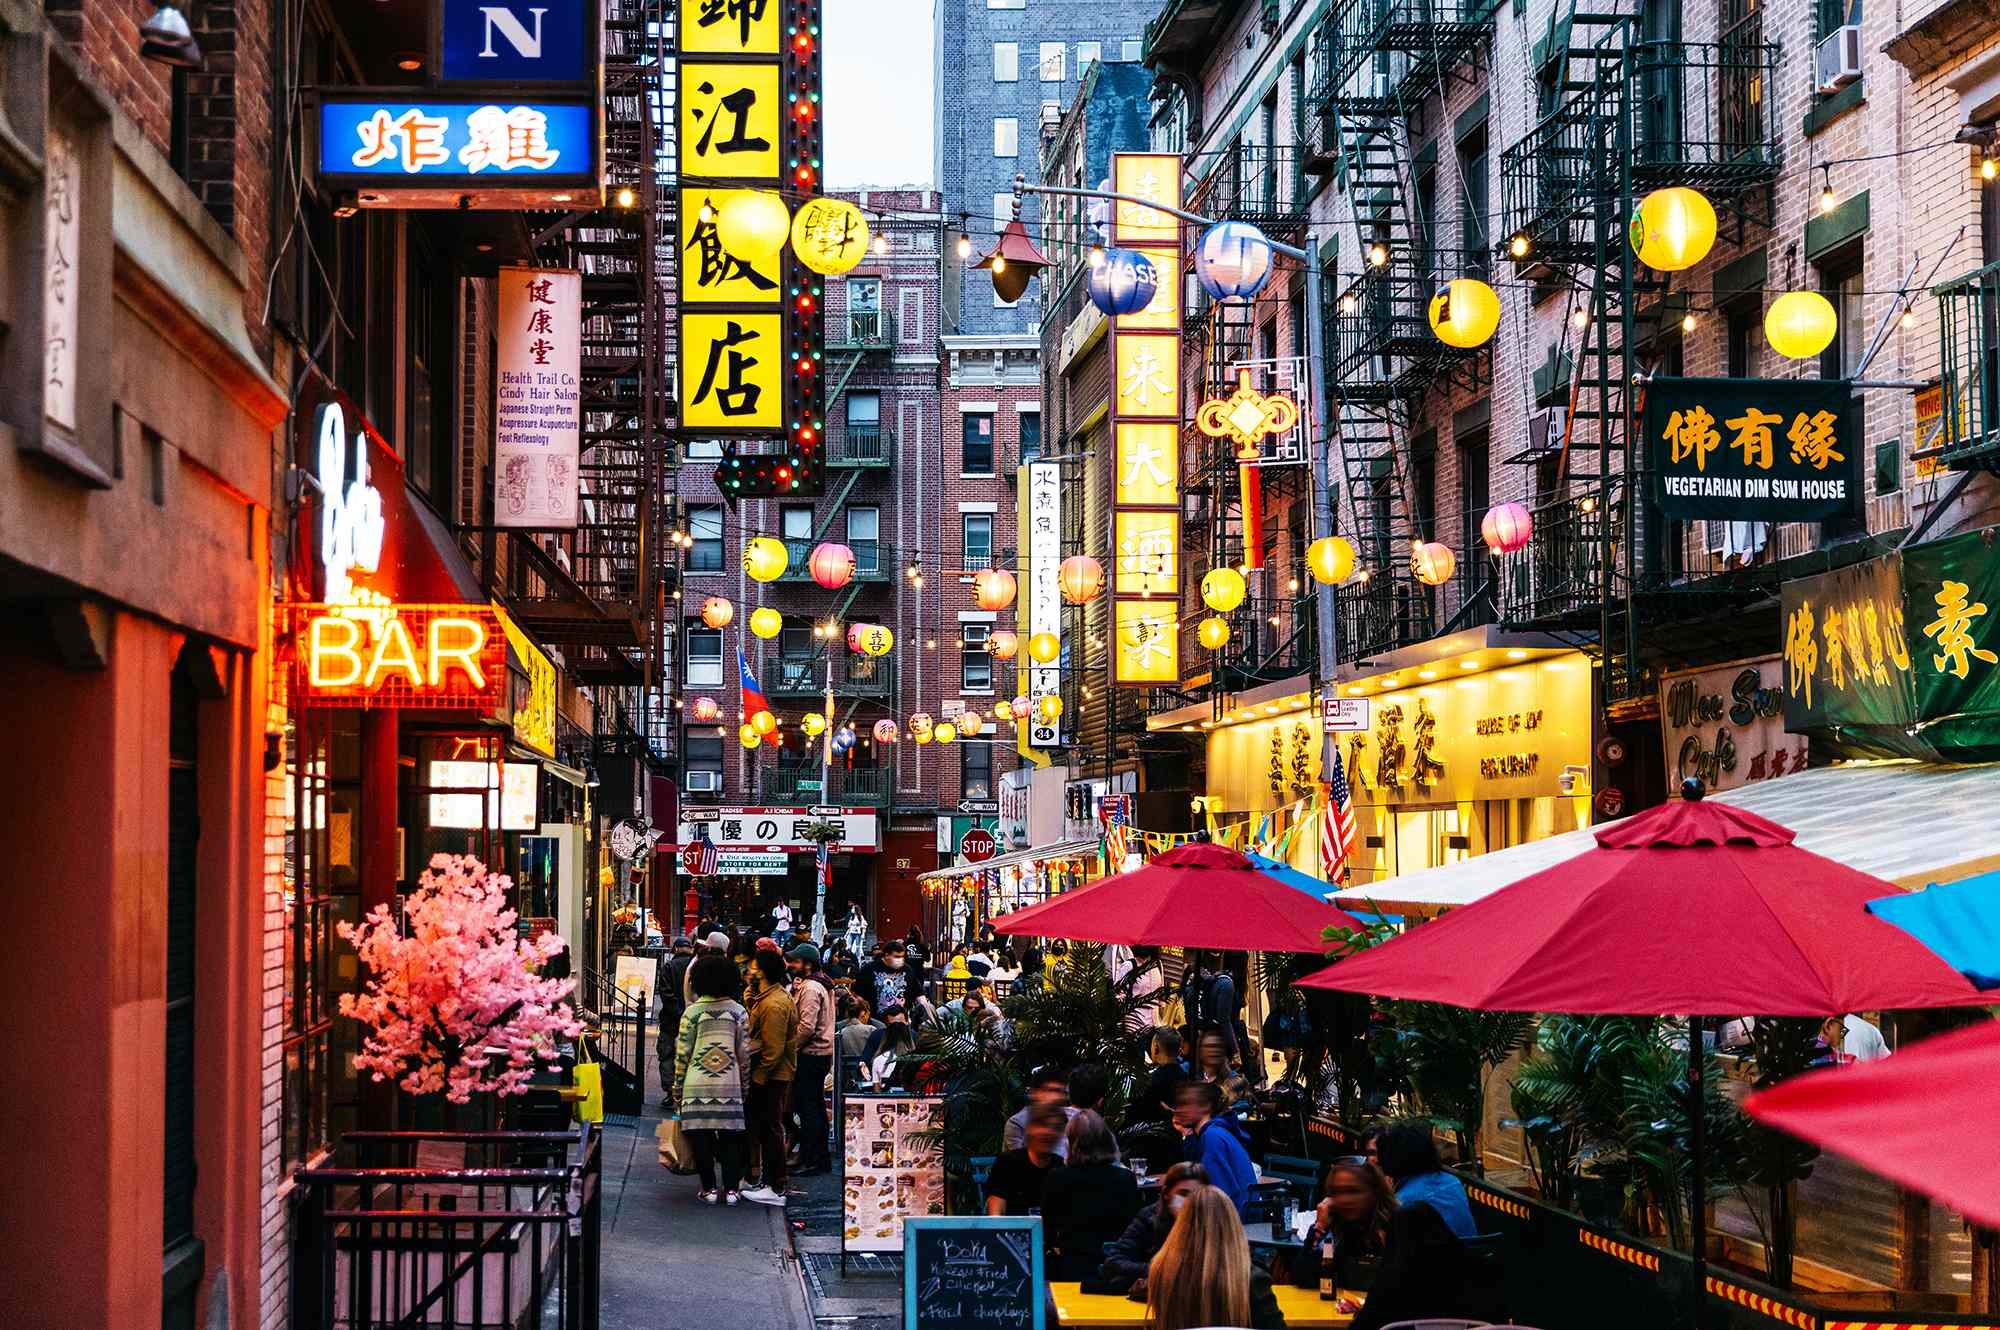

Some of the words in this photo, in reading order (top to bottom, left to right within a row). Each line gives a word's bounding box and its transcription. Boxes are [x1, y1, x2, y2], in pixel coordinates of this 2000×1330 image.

[478, 7, 549, 58] N
[351, 105, 561, 174] 炸雞
[1092, 262, 1158, 285] CHASE
[525, 279, 557, 365] 健康堂
[502, 372, 532, 385] Health
[537, 373, 558, 385] Trail
[561, 374, 576, 385] Co.
[499, 386, 526, 402] Cindy
[530, 388, 550, 400] Hair
[554, 389, 578, 401] Salon
[499, 404, 529, 416] Japanese
[530, 404, 555, 416] Straight
[556, 404, 573, 414] Perm
[499, 418, 538, 430] Acupressure
[539, 418, 578, 430] Acupuncture
[498, 432, 512, 443] Foot
[513, 432, 549, 446] Reflexology
[1662, 405, 1846, 472] 佛有緣
[1664, 476, 1742, 498] VEGETARIAN
[1744, 478, 1770, 499] DIM
[1772, 479, 1799, 499] SUM
[1801, 480, 1847, 499] HOUSE
[1923, 580, 1999, 680] 素
[309, 617, 488, 690] BAR
[1036, 730, 1052, 740] 34
[963, 839, 994, 854] STOP
